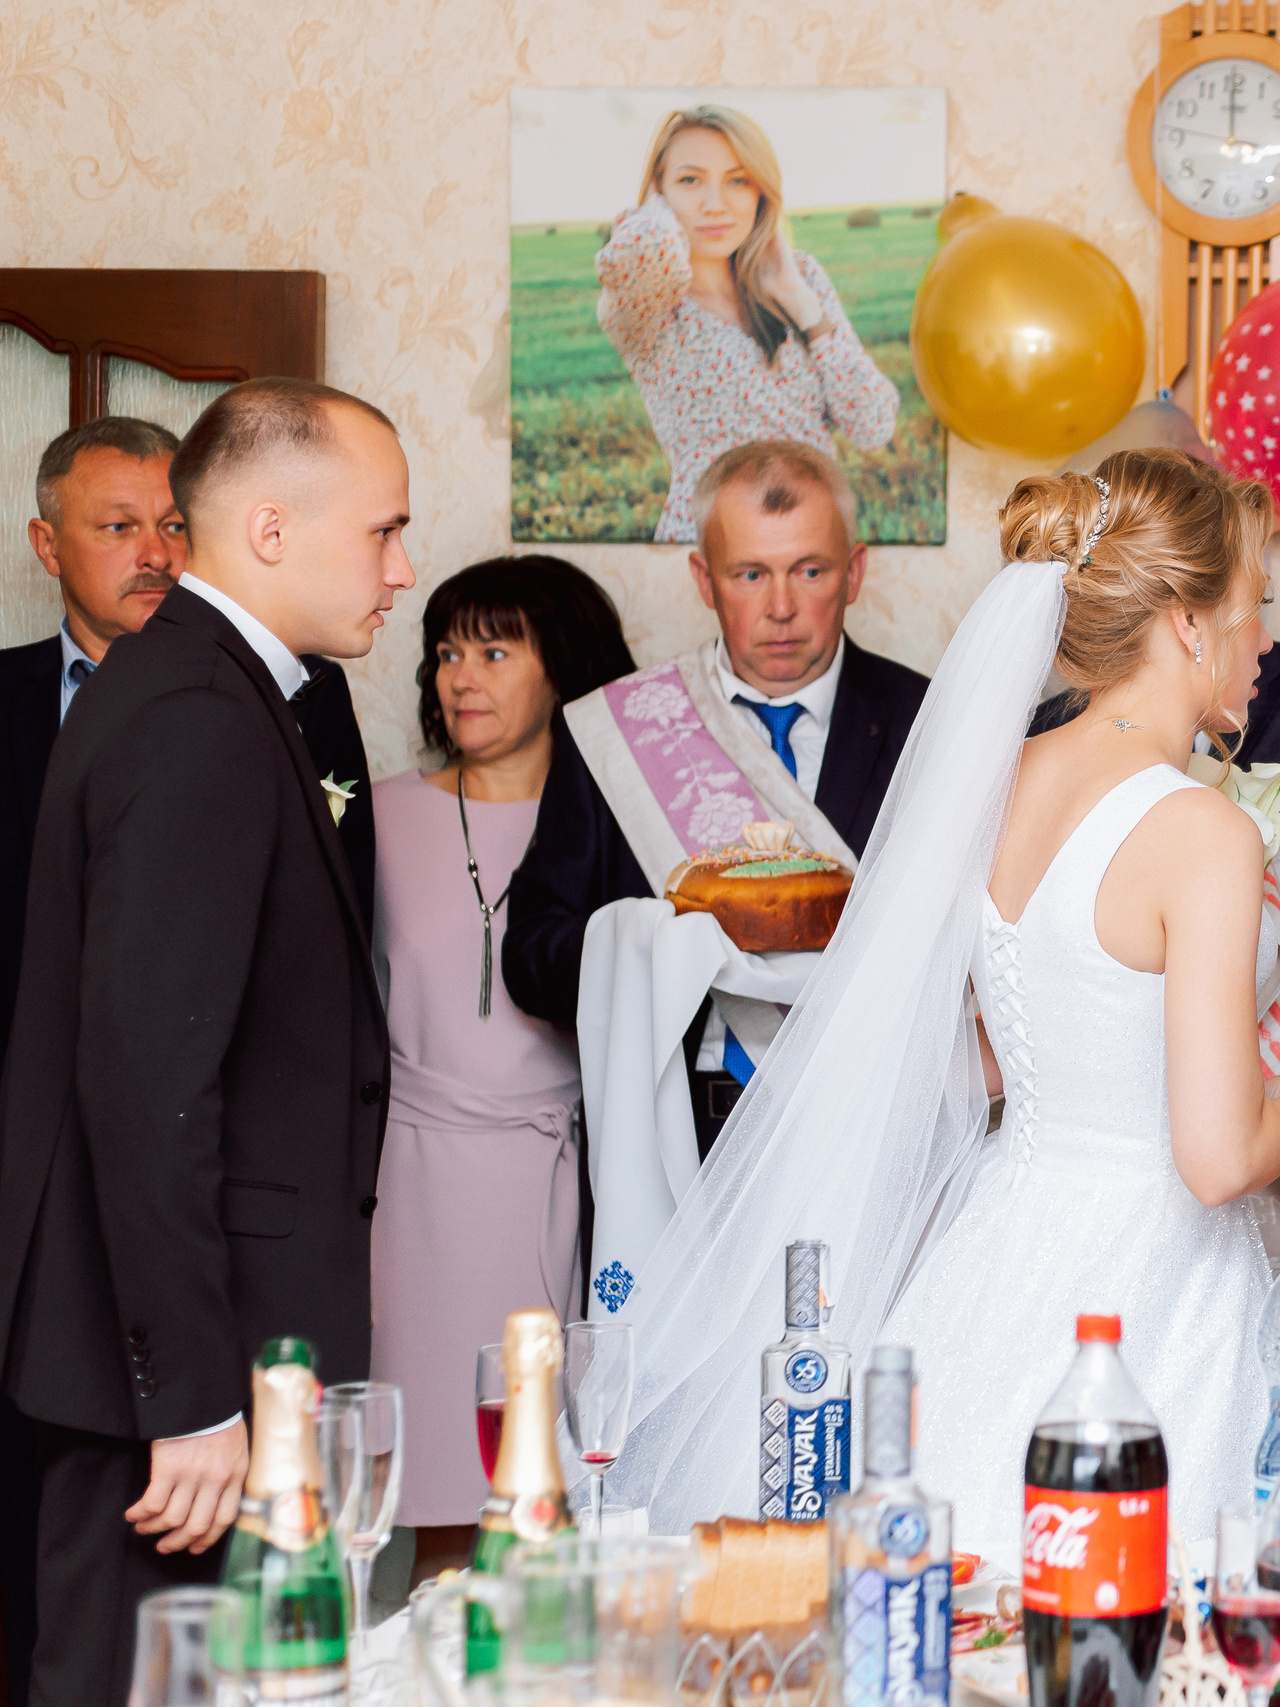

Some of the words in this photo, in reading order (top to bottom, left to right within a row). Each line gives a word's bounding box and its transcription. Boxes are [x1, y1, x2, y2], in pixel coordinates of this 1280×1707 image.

[1199, 80, 1215, 100] 11
[1223, 73, 1246, 93] 12
[1257, 81, 1266, 99] 1
[1175, 98, 1198, 118] 10
[1168, 128, 1185, 150] 9
[1177, 157, 1195, 179] 8
[1200, 178, 1215, 199] 7
[1223, 185, 1240, 207] 6
[1251, 180, 1269, 200] 5
[791, 1409, 823, 1512] SVAYAK
[825, 1425, 836, 1477] STANDARD
[791, 1511, 819, 1520] VODKA
